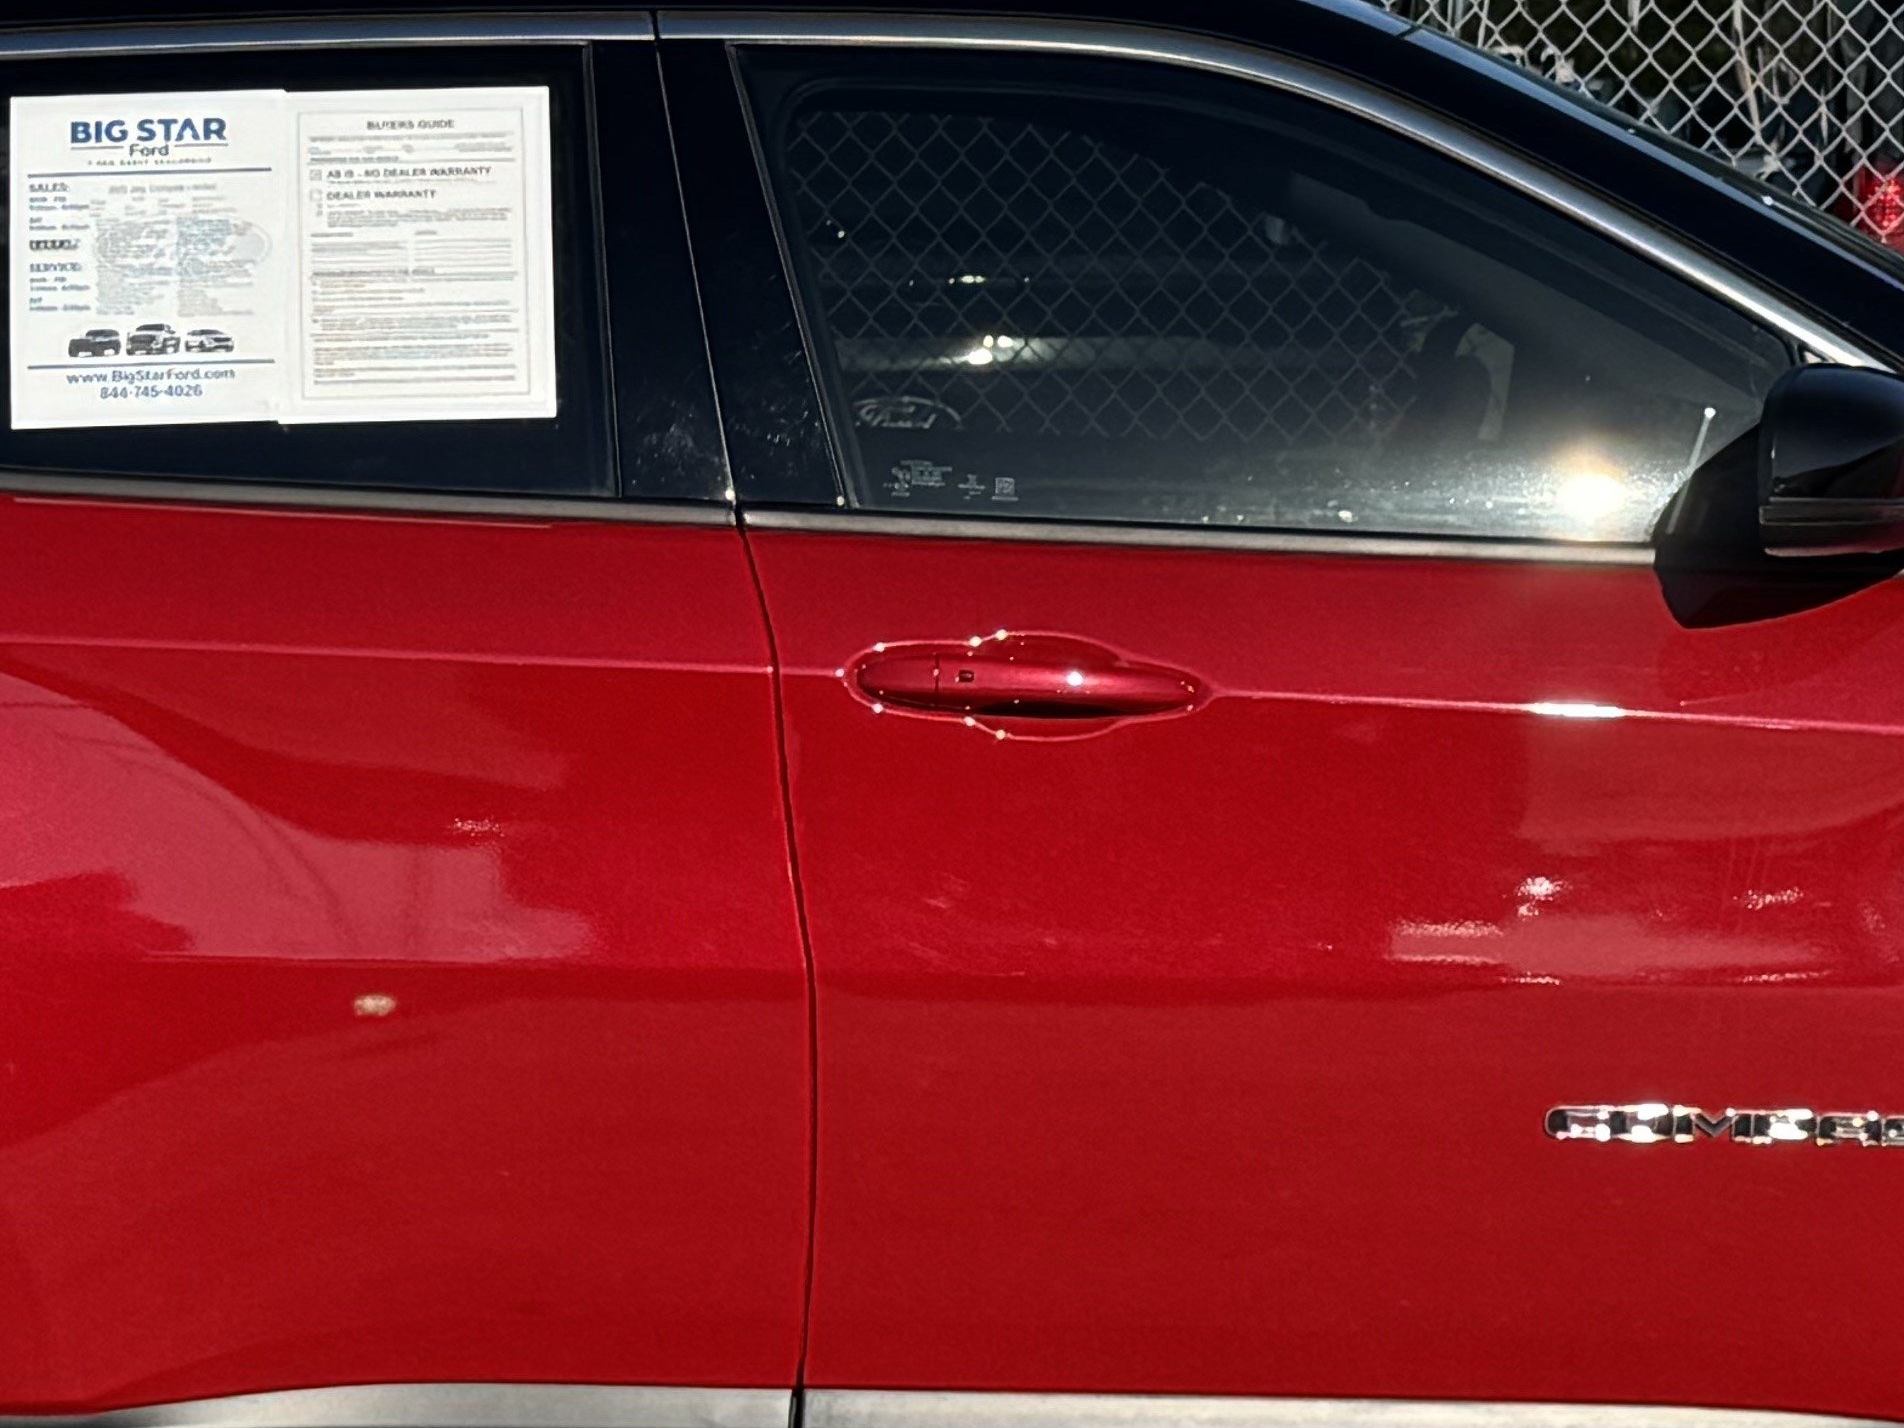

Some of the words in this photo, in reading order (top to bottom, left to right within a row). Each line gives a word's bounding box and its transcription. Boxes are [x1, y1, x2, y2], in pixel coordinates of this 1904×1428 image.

[69, 119, 128, 144] BIG
[136, 117, 228, 142] STAR
[417, 118, 455, 130] GUIDE
[128, 142, 170, 157] Ford
[363, 168, 381, 178] NO
[382, 167, 427, 178] DEALER
[429, 165, 493, 176] WARRANTY
[326, 189, 371, 200] DEALER
[374, 188, 437, 199] WARRANTY
